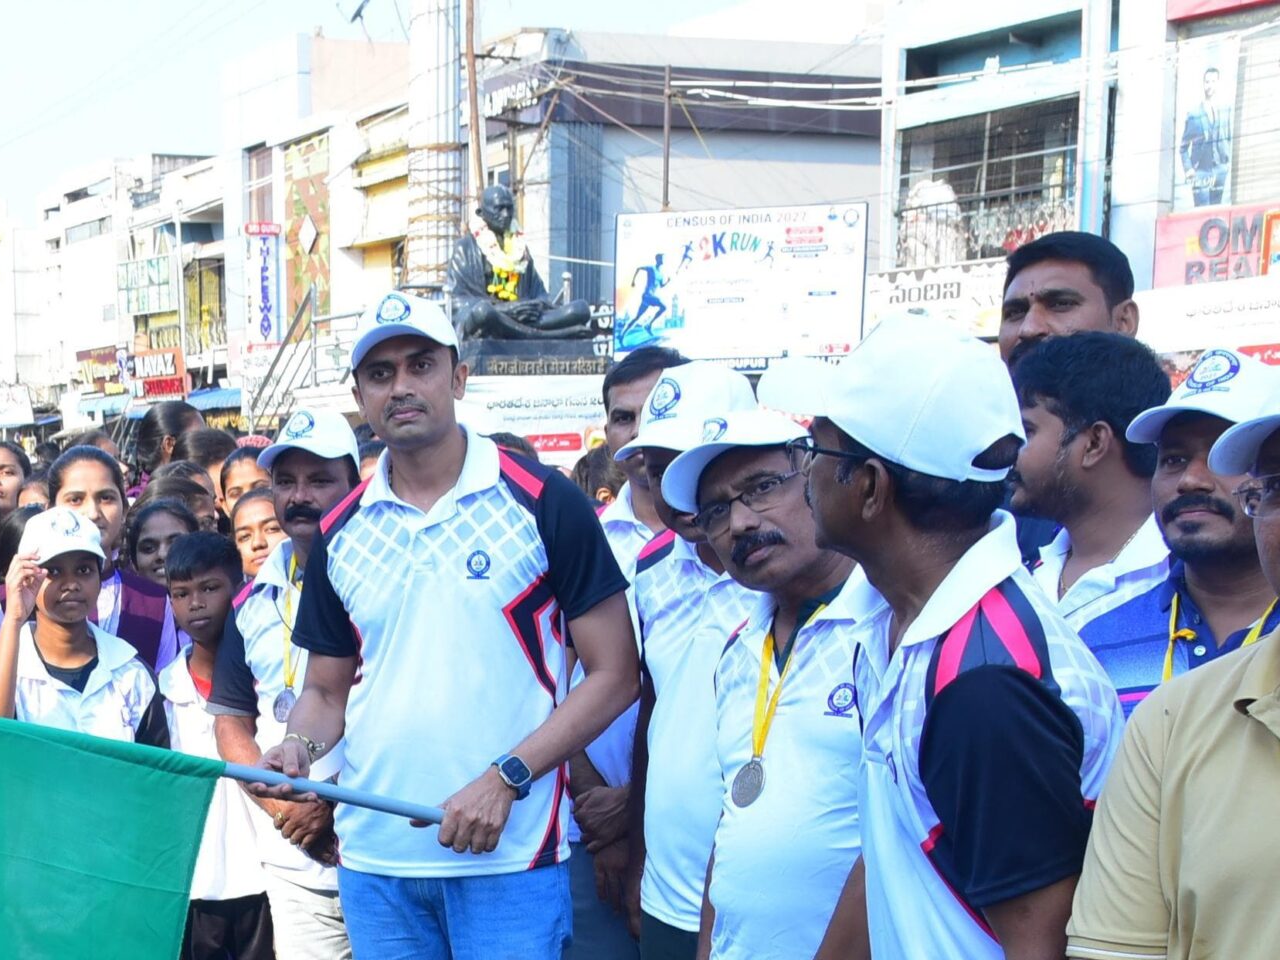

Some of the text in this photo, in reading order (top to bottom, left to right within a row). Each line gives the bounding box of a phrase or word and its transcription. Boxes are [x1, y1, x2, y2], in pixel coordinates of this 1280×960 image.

[666, 215, 716, 228] CENSUS
[719, 214, 733, 225] OF
[738, 212, 772, 224] INDIA
[729, 232, 762, 253] RUN
